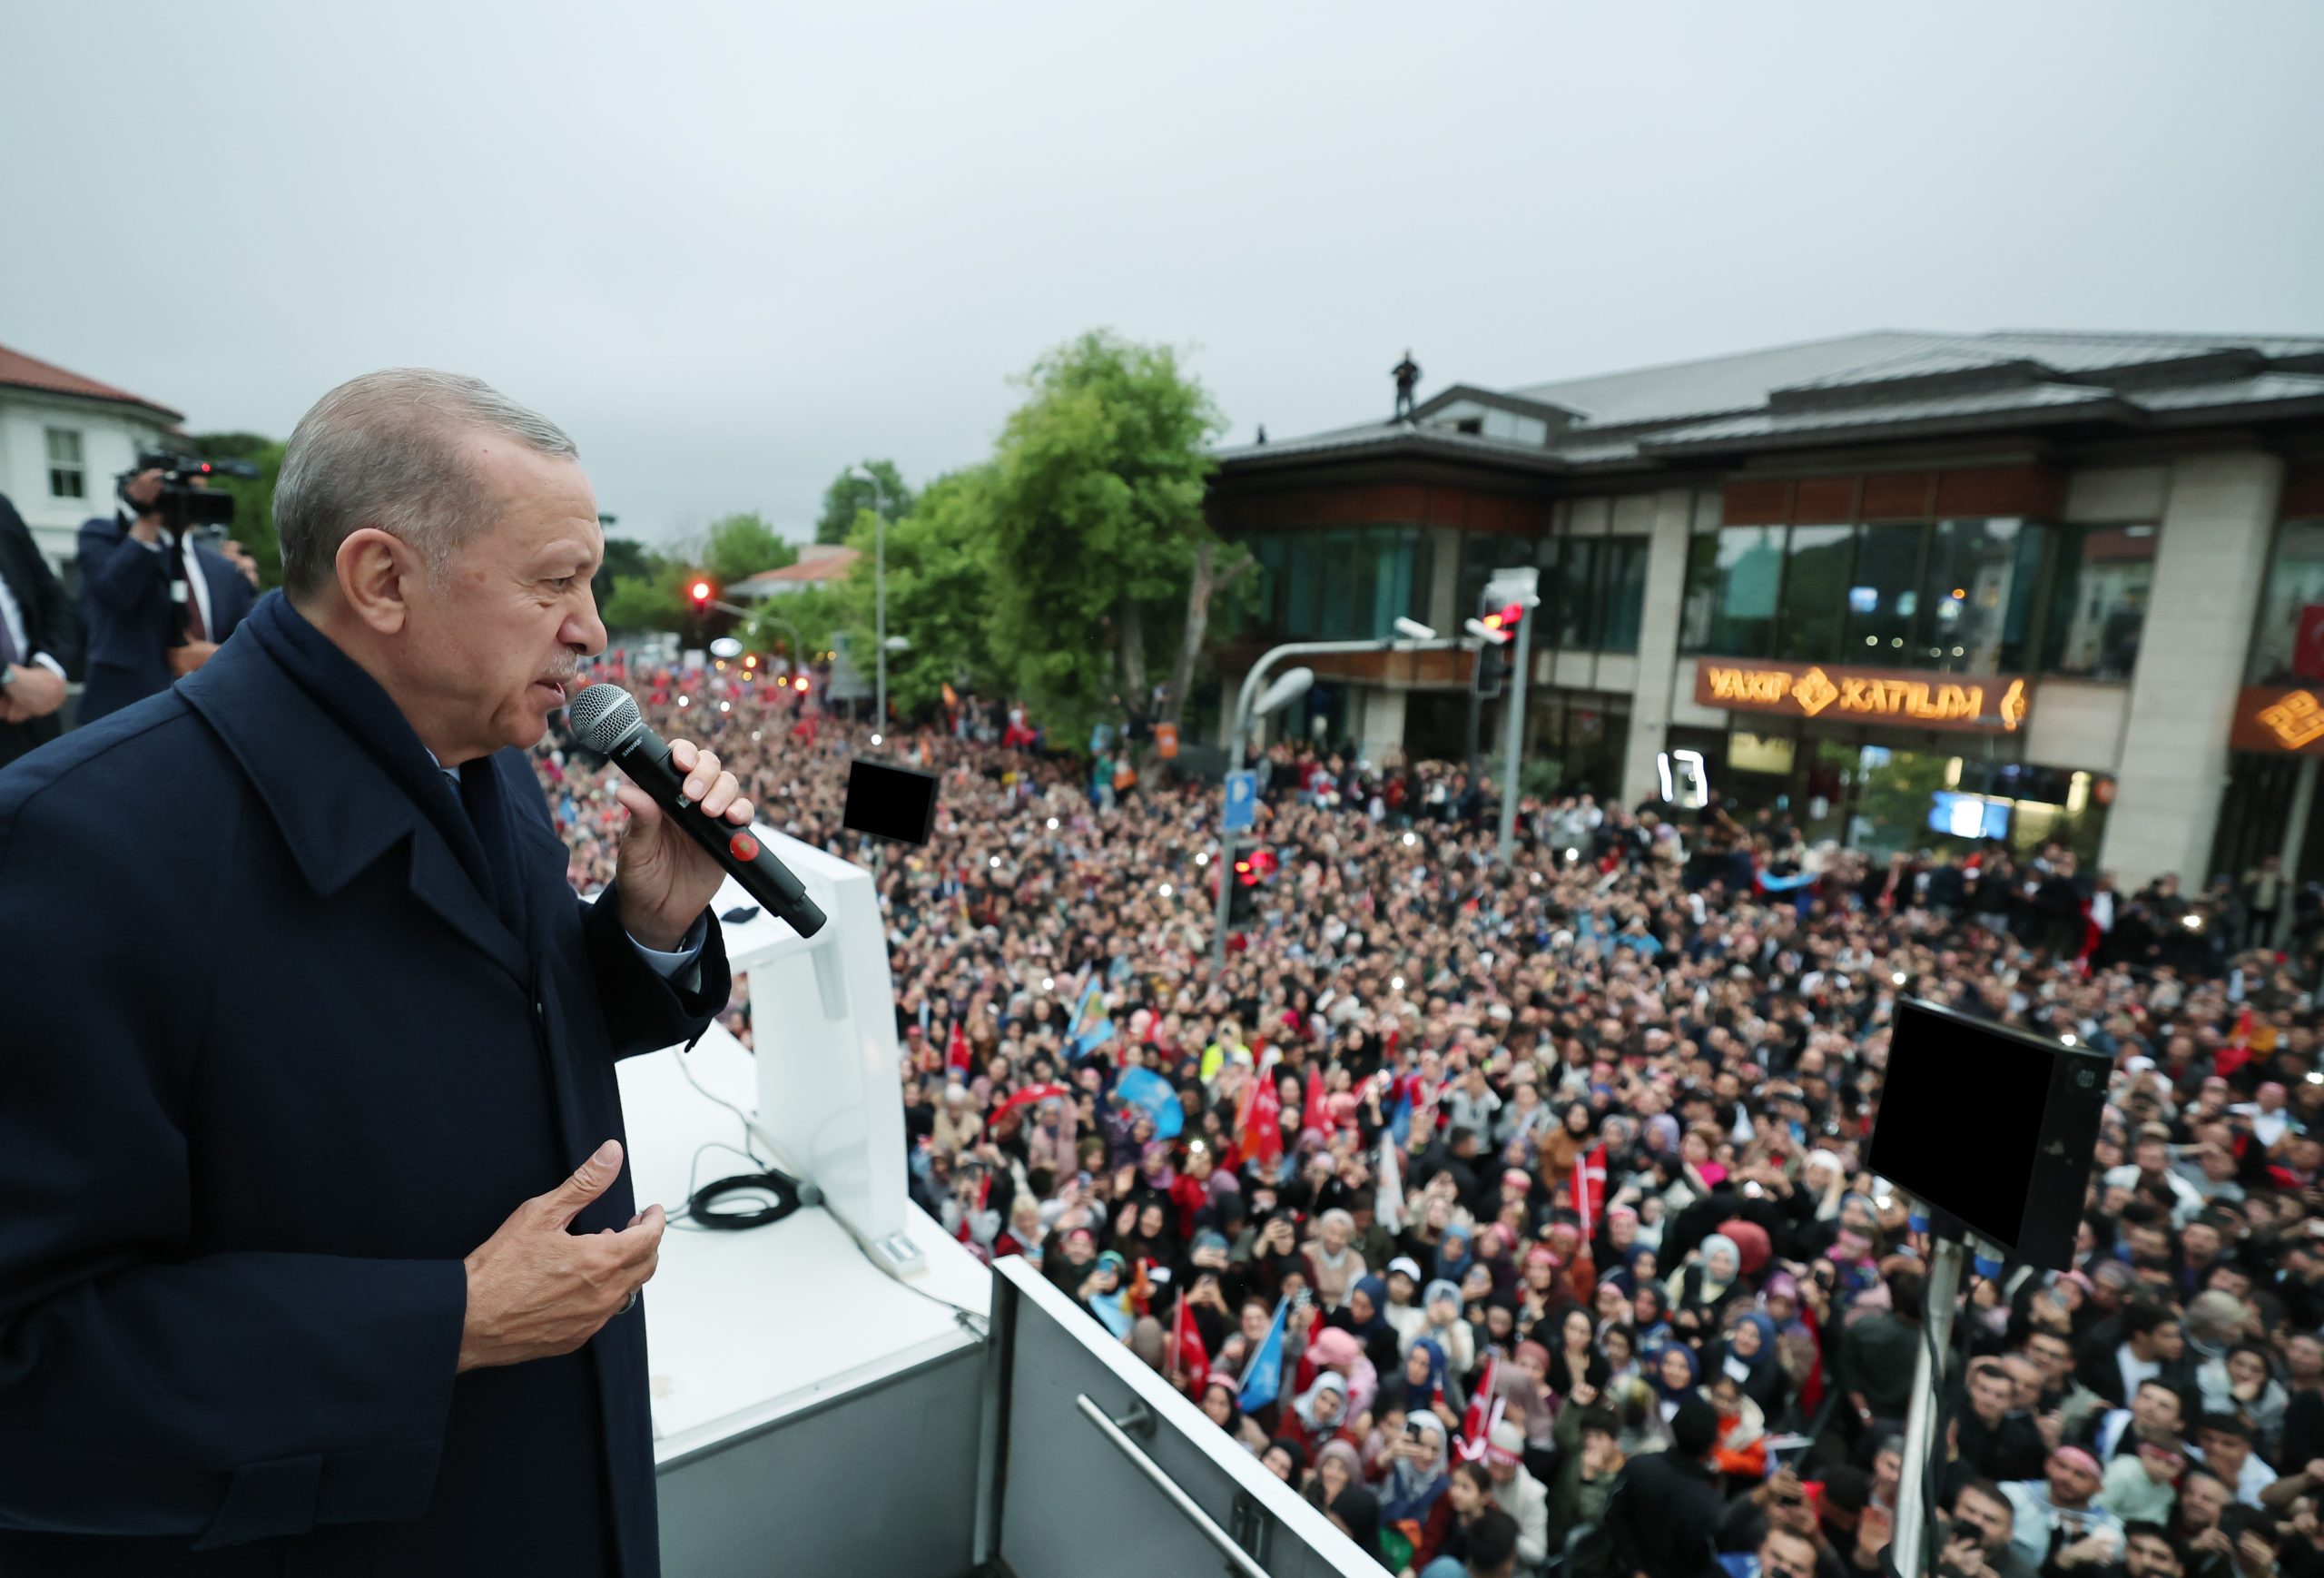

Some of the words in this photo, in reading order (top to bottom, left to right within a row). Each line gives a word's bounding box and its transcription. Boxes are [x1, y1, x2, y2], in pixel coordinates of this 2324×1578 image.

[1708, 666, 1792, 705] VAKIF
[1839, 676, 1983, 721] KATILIM
[622, 736, 644, 757] SHURE
